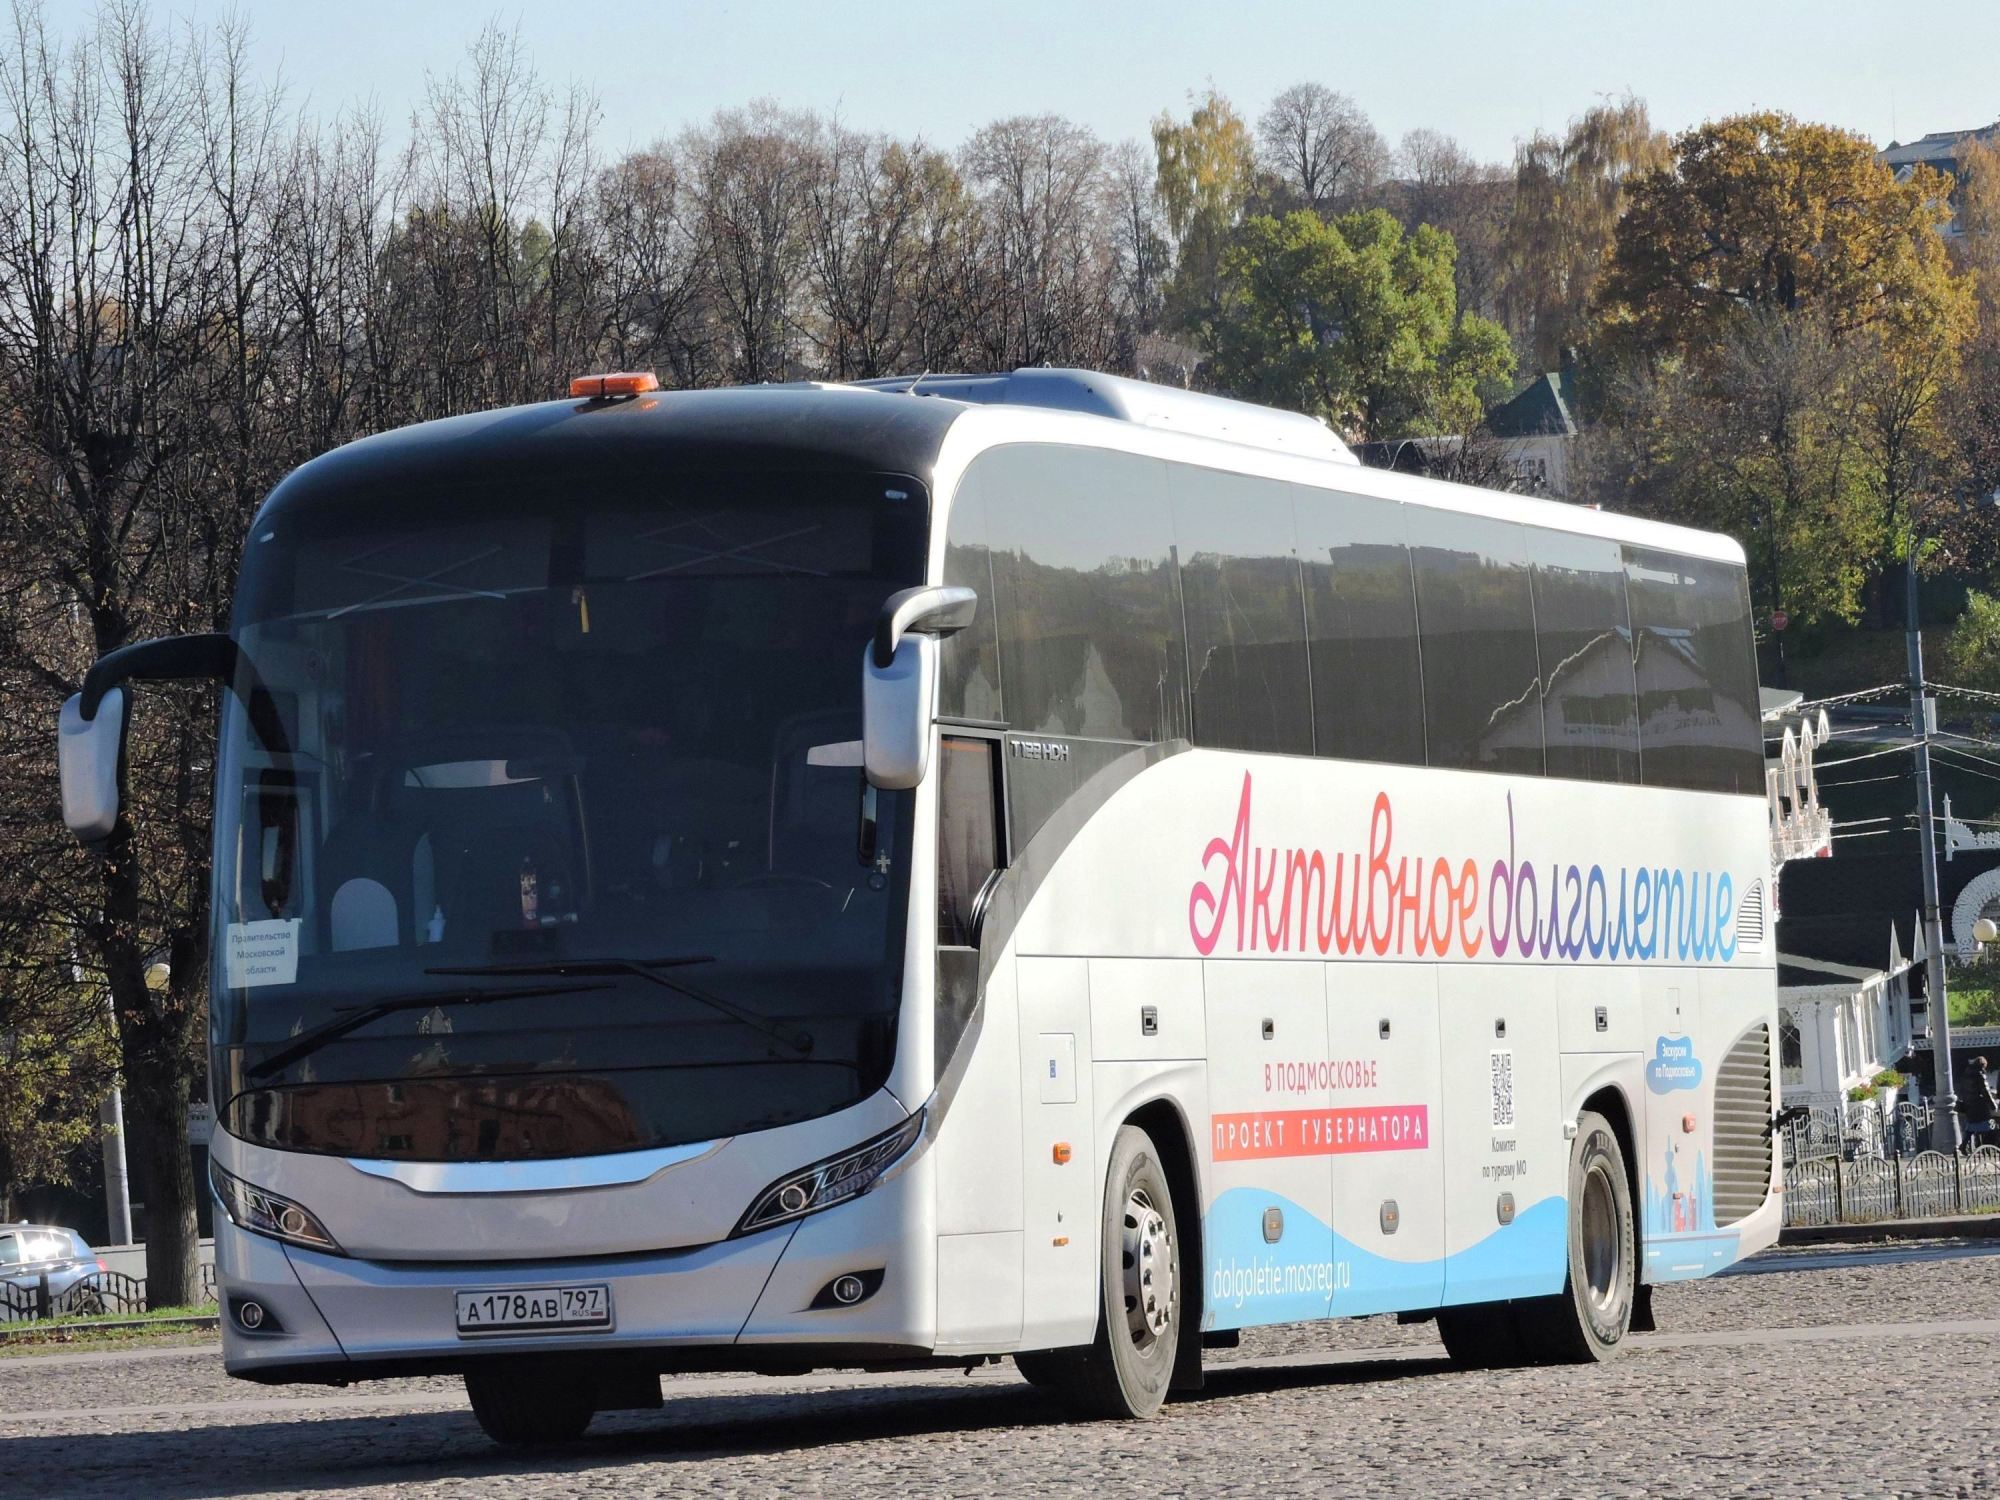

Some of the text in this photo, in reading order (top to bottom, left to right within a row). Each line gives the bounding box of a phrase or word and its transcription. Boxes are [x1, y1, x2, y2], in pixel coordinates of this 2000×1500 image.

[1188, 768, 1738, 963] Активное долголетие
[231, 932, 291, 944] Правительство
[236, 947, 285, 959] Московской
[245, 966, 277, 975] области
[1264, 1060, 1377, 1096] В ПОДМОСКОВЬЕ
[1216, 1114, 1423, 1150] ПРОЕКТ ГУБЕРНАТОРА
[1491, 1136, 1516, 1152] Комитет
[1482, 1160, 1526, 1182] по туризму МО
[1212, 1256, 1350, 1308] dolgoletie.mosreg.ru
[563, 1290, 599, 1310] 797
